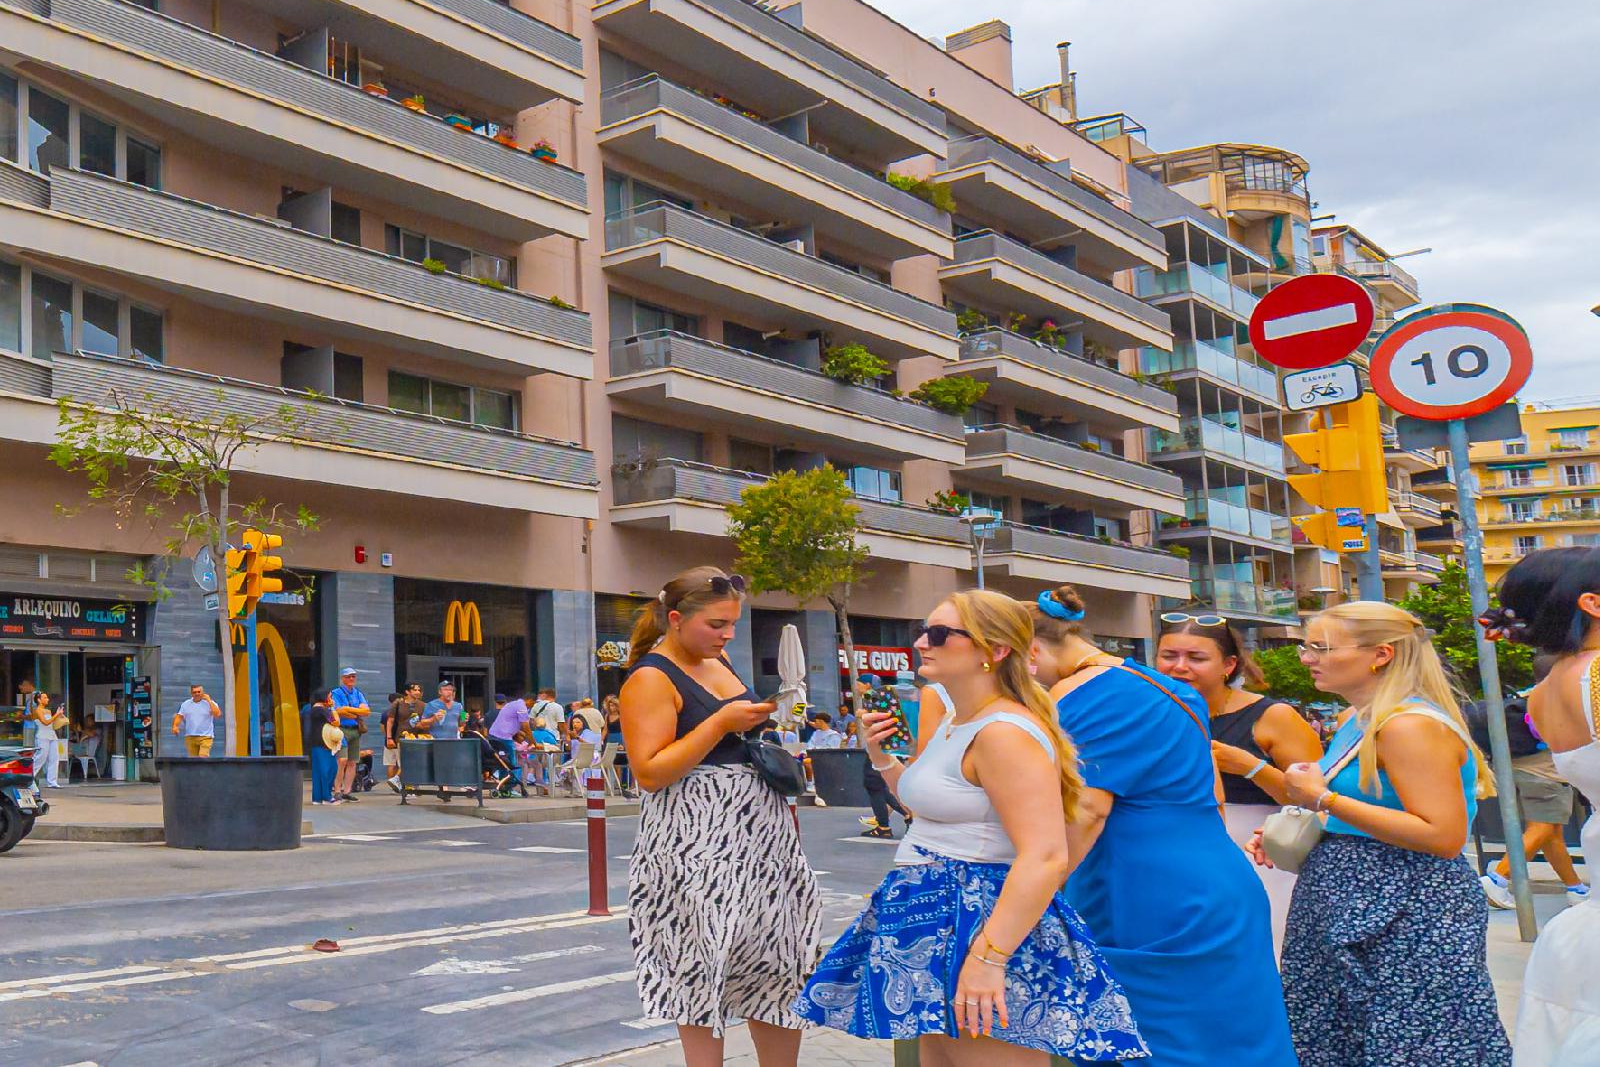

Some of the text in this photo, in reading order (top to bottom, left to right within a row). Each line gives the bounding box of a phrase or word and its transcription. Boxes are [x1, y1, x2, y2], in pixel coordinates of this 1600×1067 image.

[1411, 345, 1489, 385] 10
[13, 598, 80, 619] ARLEQUINO
[86, 609, 126, 624] GELATO
[869, 651, 909, 671] GUYS
